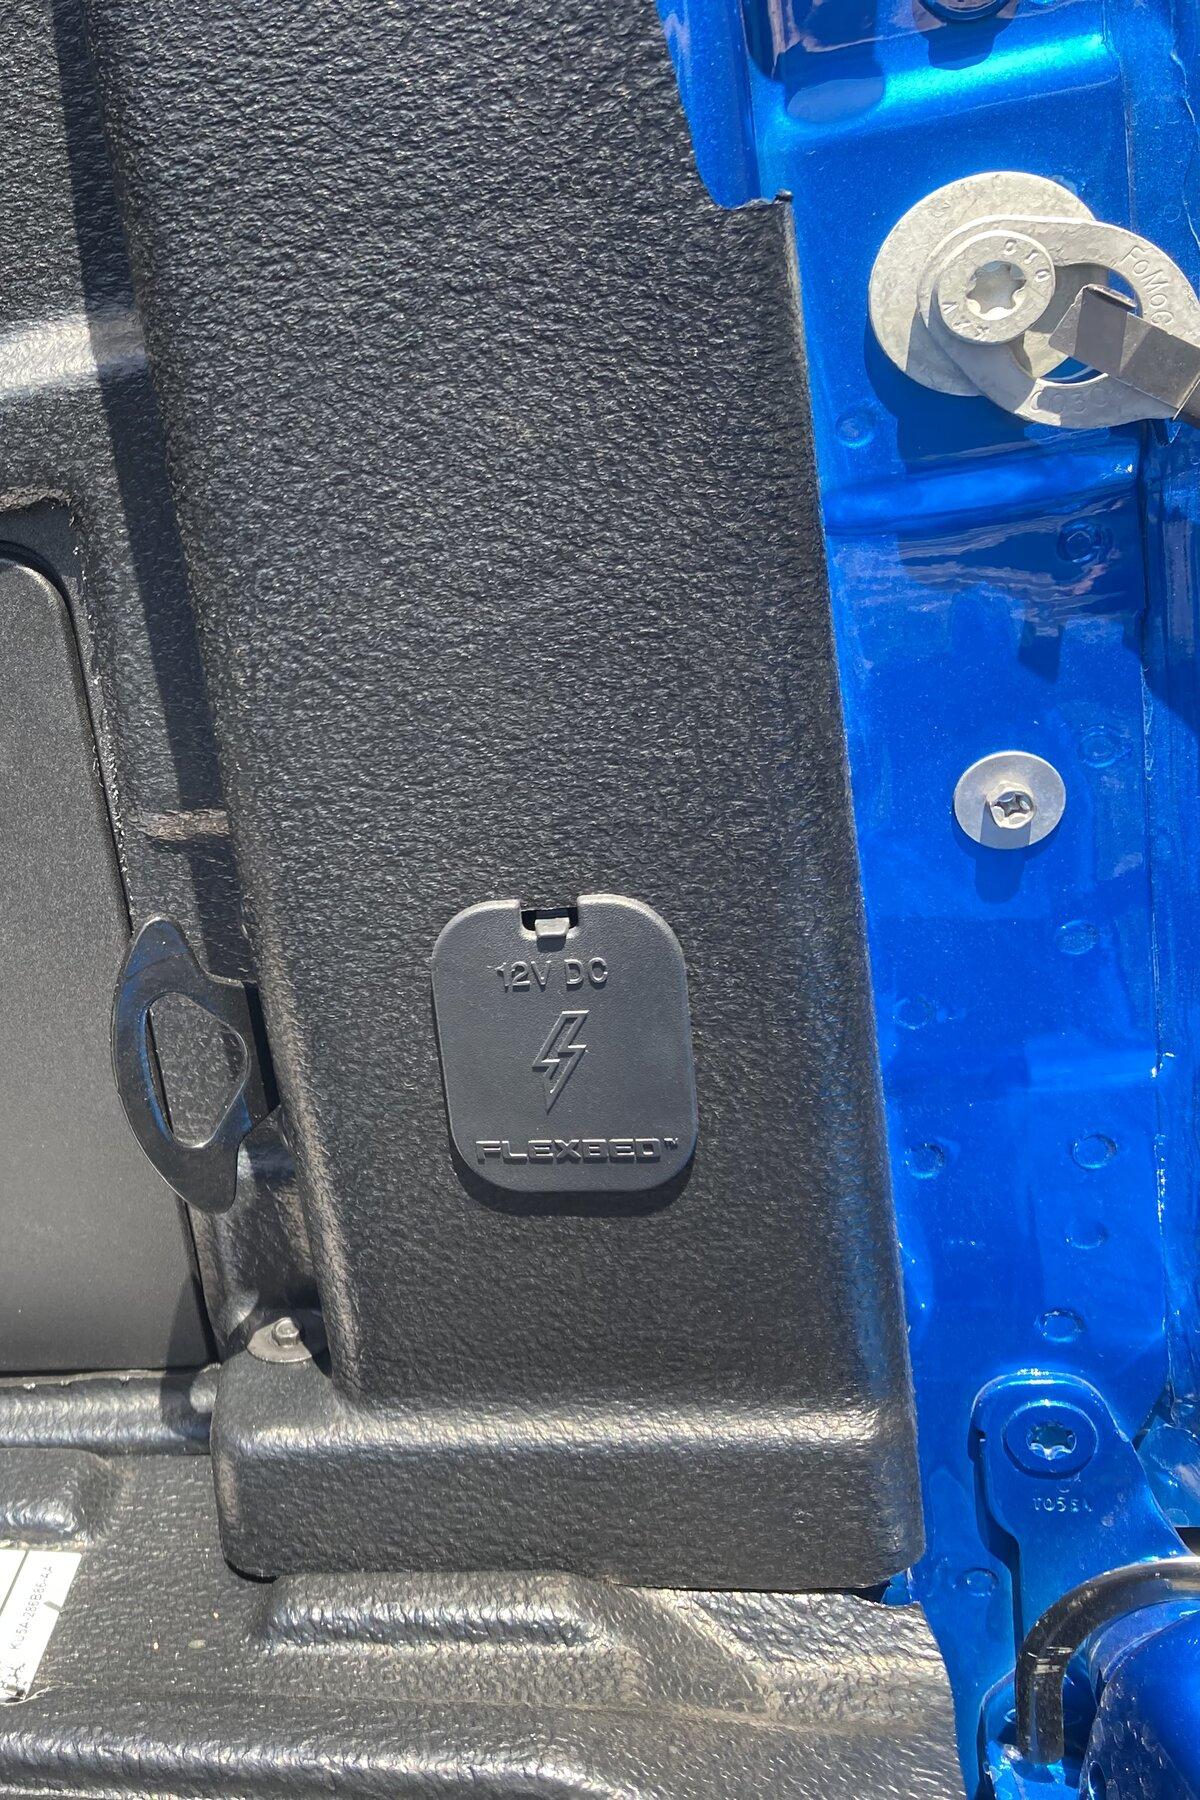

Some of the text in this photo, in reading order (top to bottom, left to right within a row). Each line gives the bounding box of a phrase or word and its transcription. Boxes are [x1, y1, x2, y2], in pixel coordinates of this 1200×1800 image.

[1120, 245, 1175, 325] FoMoC
[494, 956, 608, 990] 12V DC
